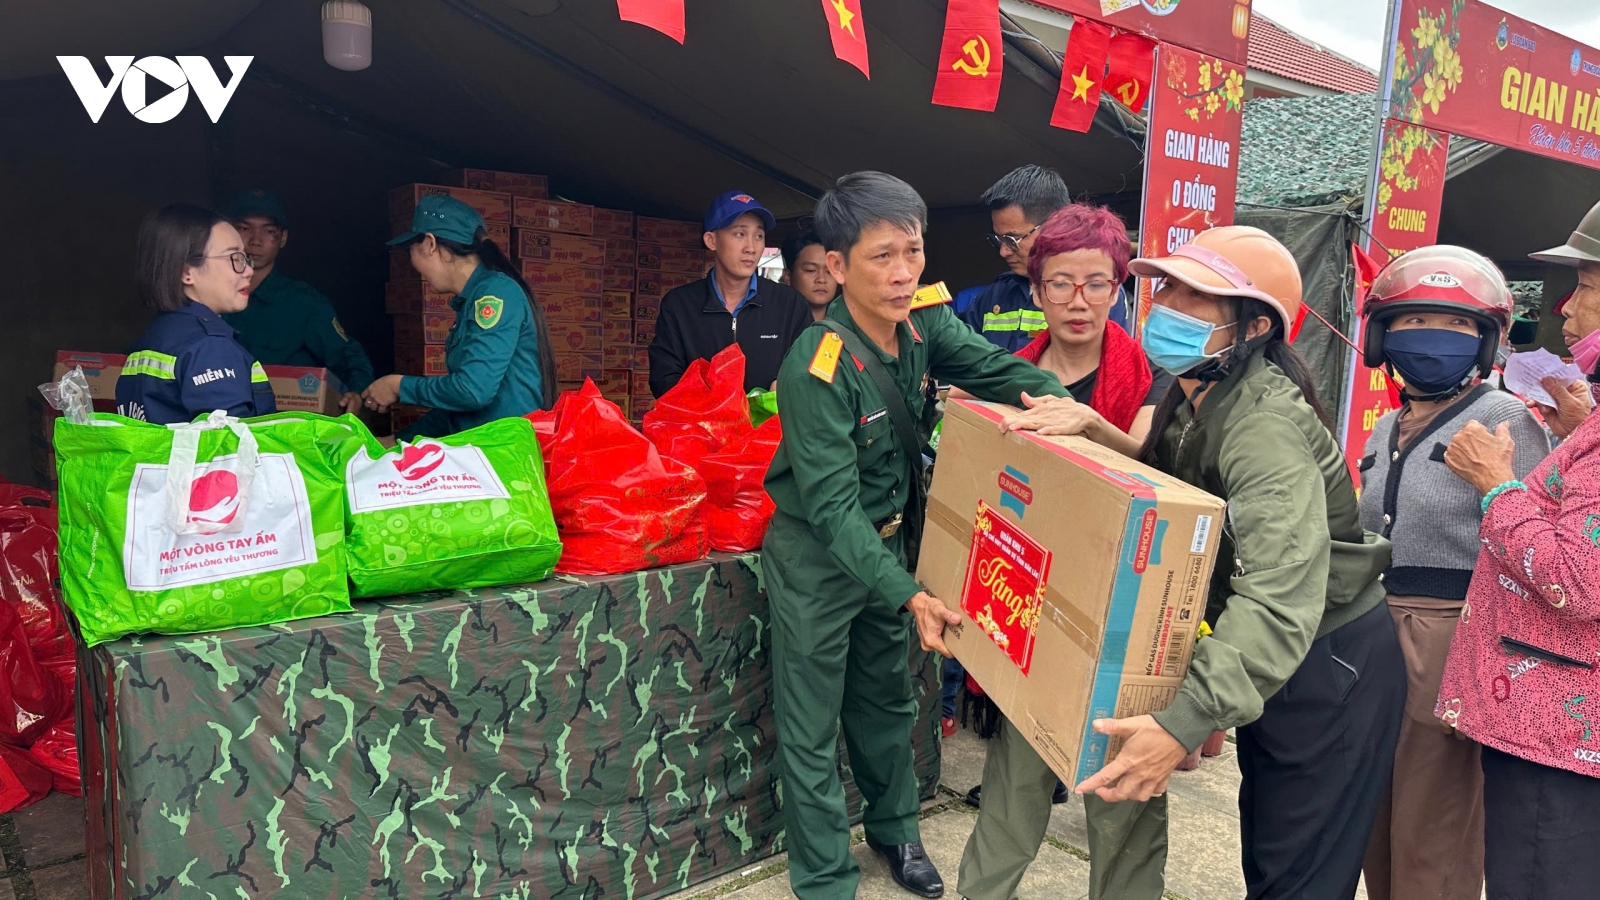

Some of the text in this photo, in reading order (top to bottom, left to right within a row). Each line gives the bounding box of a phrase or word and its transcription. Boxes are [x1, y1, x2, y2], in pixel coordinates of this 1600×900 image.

[1501, 66, 1568, 124] GIAN
[1164, 128, 1230, 168] GIAN HÀNG
[1183, 173, 1217, 212] ĐỒNG
[1388, 206, 1426, 232] CHUNG
[439, 474, 459, 482] TAY
[1000, 476, 1031, 501] SUNHOUSE
[159, 530, 277, 562] MỘT VÒNG TAY ẤM
[179, 562, 198, 572] TẤM
[199, 557, 223, 568] LÒNG
[223, 553, 240, 565] YÊU
[241, 548, 279, 561] THƯƠNG
[1136, 514, 1154, 569] SUNHOUSE
[978, 557, 1023, 626] Tặng
[1157, 606, 1165, 625] KÍNH
[1163, 569, 1175, 607] SUNHOUSE
[1186, 594, 1194, 605] Tel:
[1190, 575, 1198, 591] 1800
[1194, 557, 1202, 575] 6680
[1154, 605, 1174, 677] MODEL: SHB307-MT
